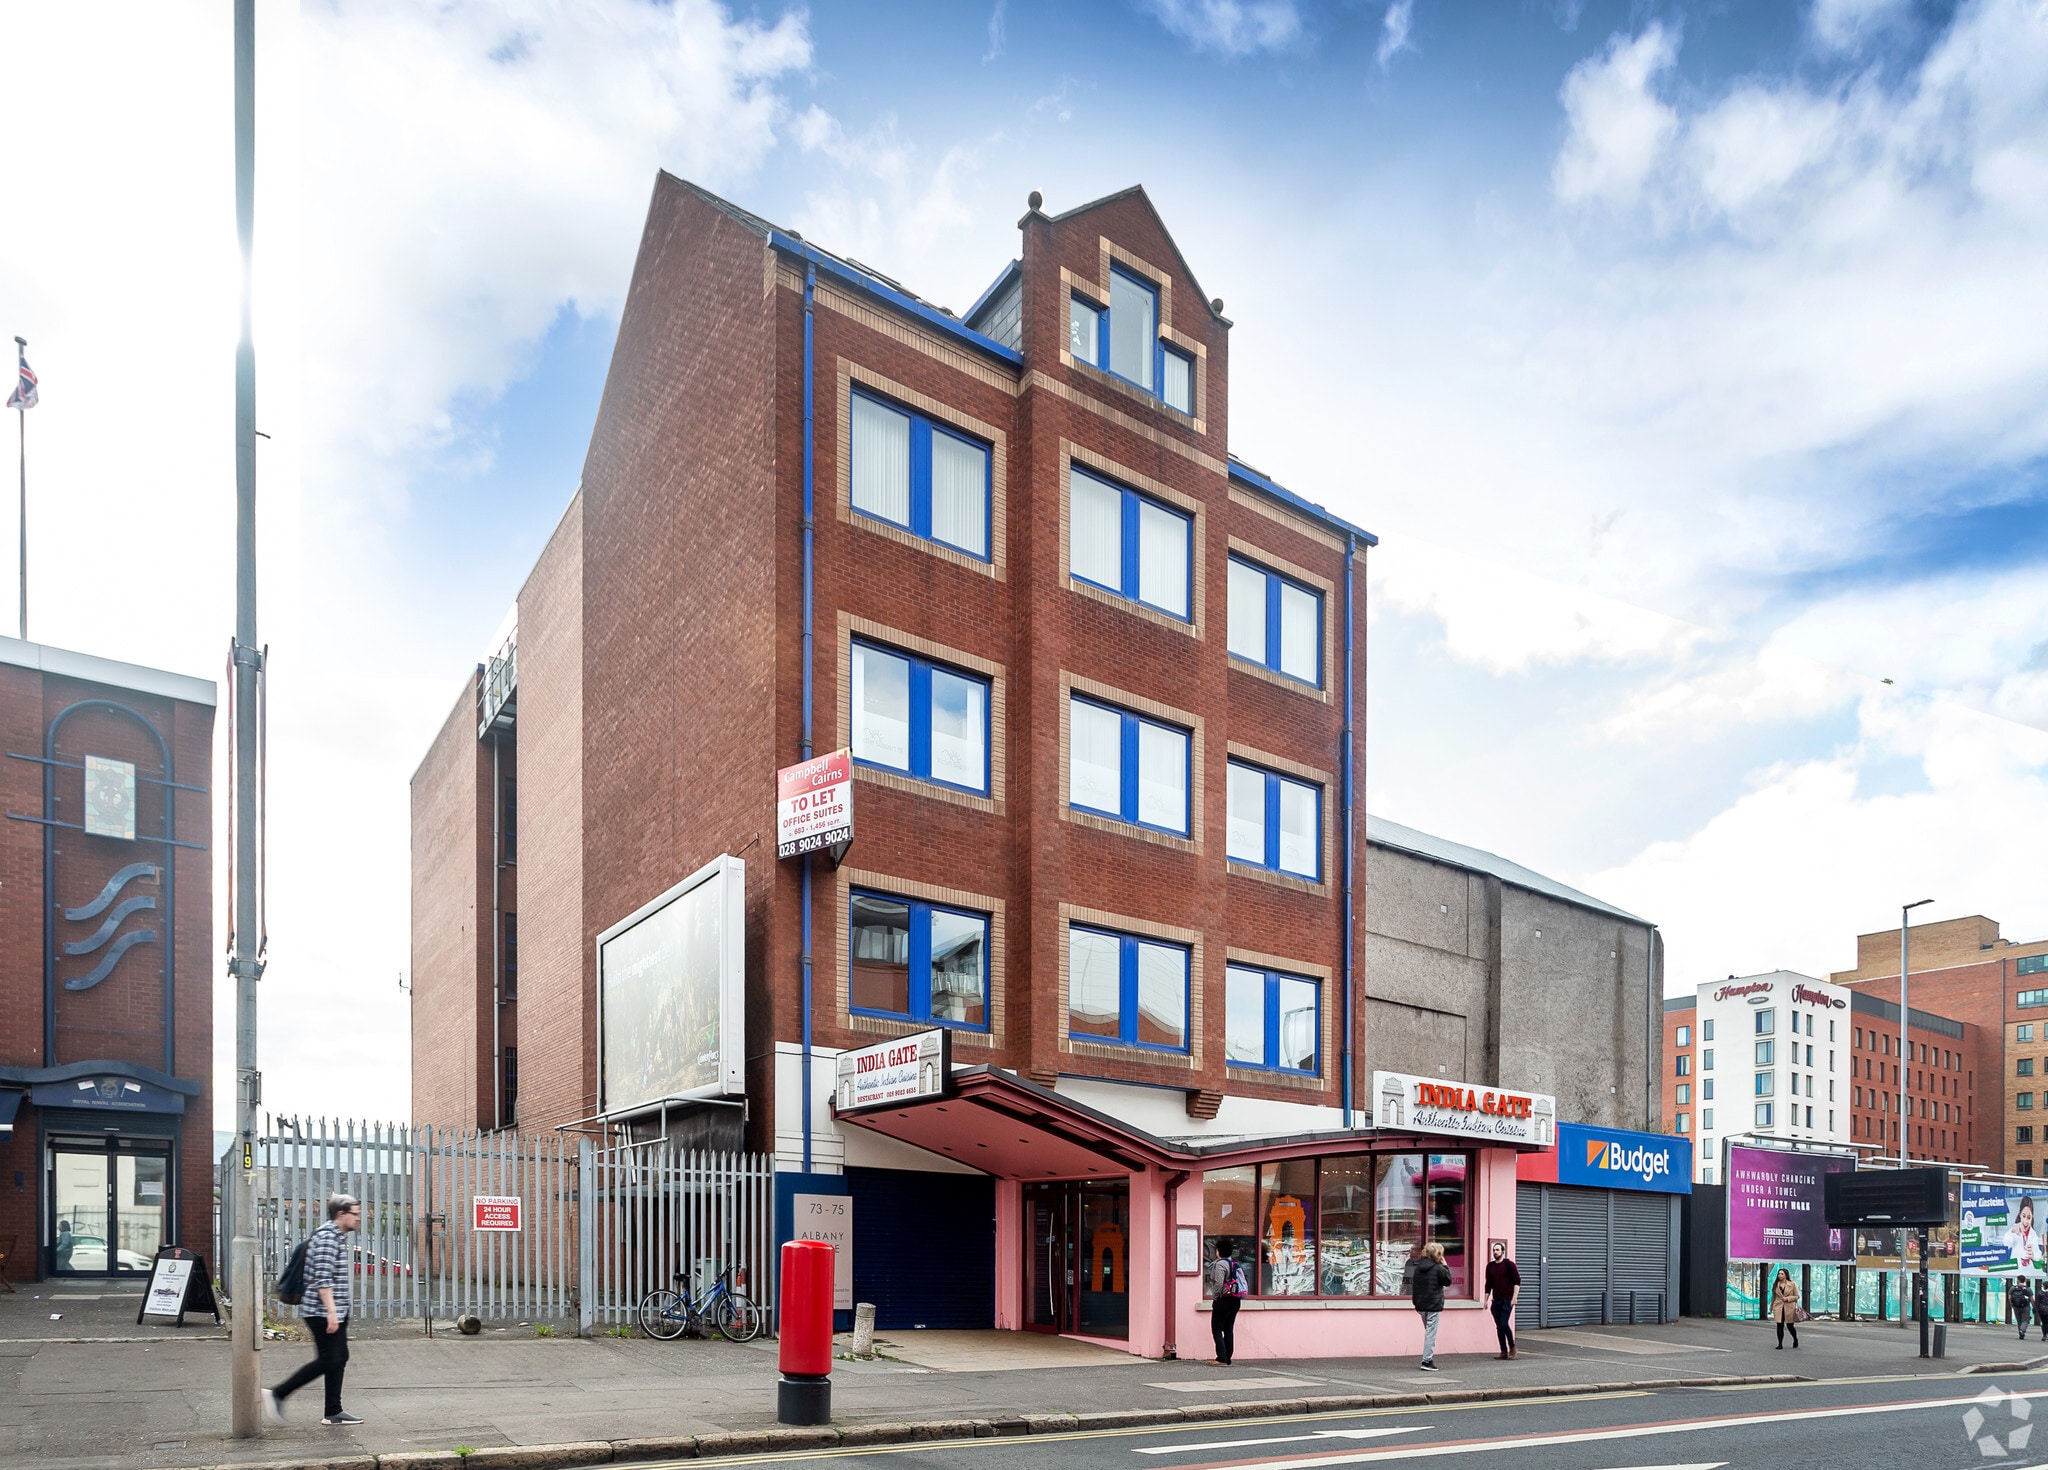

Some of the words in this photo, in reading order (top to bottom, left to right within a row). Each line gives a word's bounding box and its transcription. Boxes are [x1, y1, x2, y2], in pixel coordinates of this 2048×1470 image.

[784, 759, 828, 783] Campbell
[812, 769, 843, 786] Cairns
[791, 797, 808, 814] TO
[813, 788, 836, 808] LET
[783, 813, 810, 828] OFFICE
[814, 804, 844, 820] SUITES
[780, 842, 796, 857] 028
[799, 834, 822, 852] 9024
[825, 828, 848, 845] 9024
[1714, 982, 1774, 1002] Hampton
[1792, 984, 1832, 1008] Hampton
[856, 1052, 886, 1074] INDIA
[888, 1044, 918, 1068] GATE
[856, 1075, 879, 1092] Authentic
[880, 1072, 897, 1087] Indian
[898, 1070, 917, 1084] Cuisine
[857, 1092, 884, 1103] RESTAURANT
[1416, 1082, 1478, 1112] INDIA
[1480, 1092, 1532, 1118] GATE
[1413, 1110, 1460, 1130] Authentic
[1461, 1116, 1493, 1133] Indian
[1495, 1120, 1527, 1137] Cuisine
[1610, 1142, 1670, 1182] Budget
[1736, 1170, 1778, 1182] AWKWARDLY
[1782, 1174, 1816, 1185] CHANGING
[1741, 1184, 1764, 1194] UNDER
[1768, 1186, 1771, 1195] A
[1775, 1187, 1797, 1197] TOWEL
[810, 1203, 822, 1214] 73
[832, 1204, 844, 1215] 75
[1746, 1198, 1754, 1207] IS
[1758, 1199, 1788, 1209] THIRSTY
[1791, 1201, 1811, 1211] WORK
[1978, 1197, 2005, 1208] Einsteins
[801, 1231, 844, 1240] ALBANY
[1778, 1238, 1794, 1246] SUGAR
